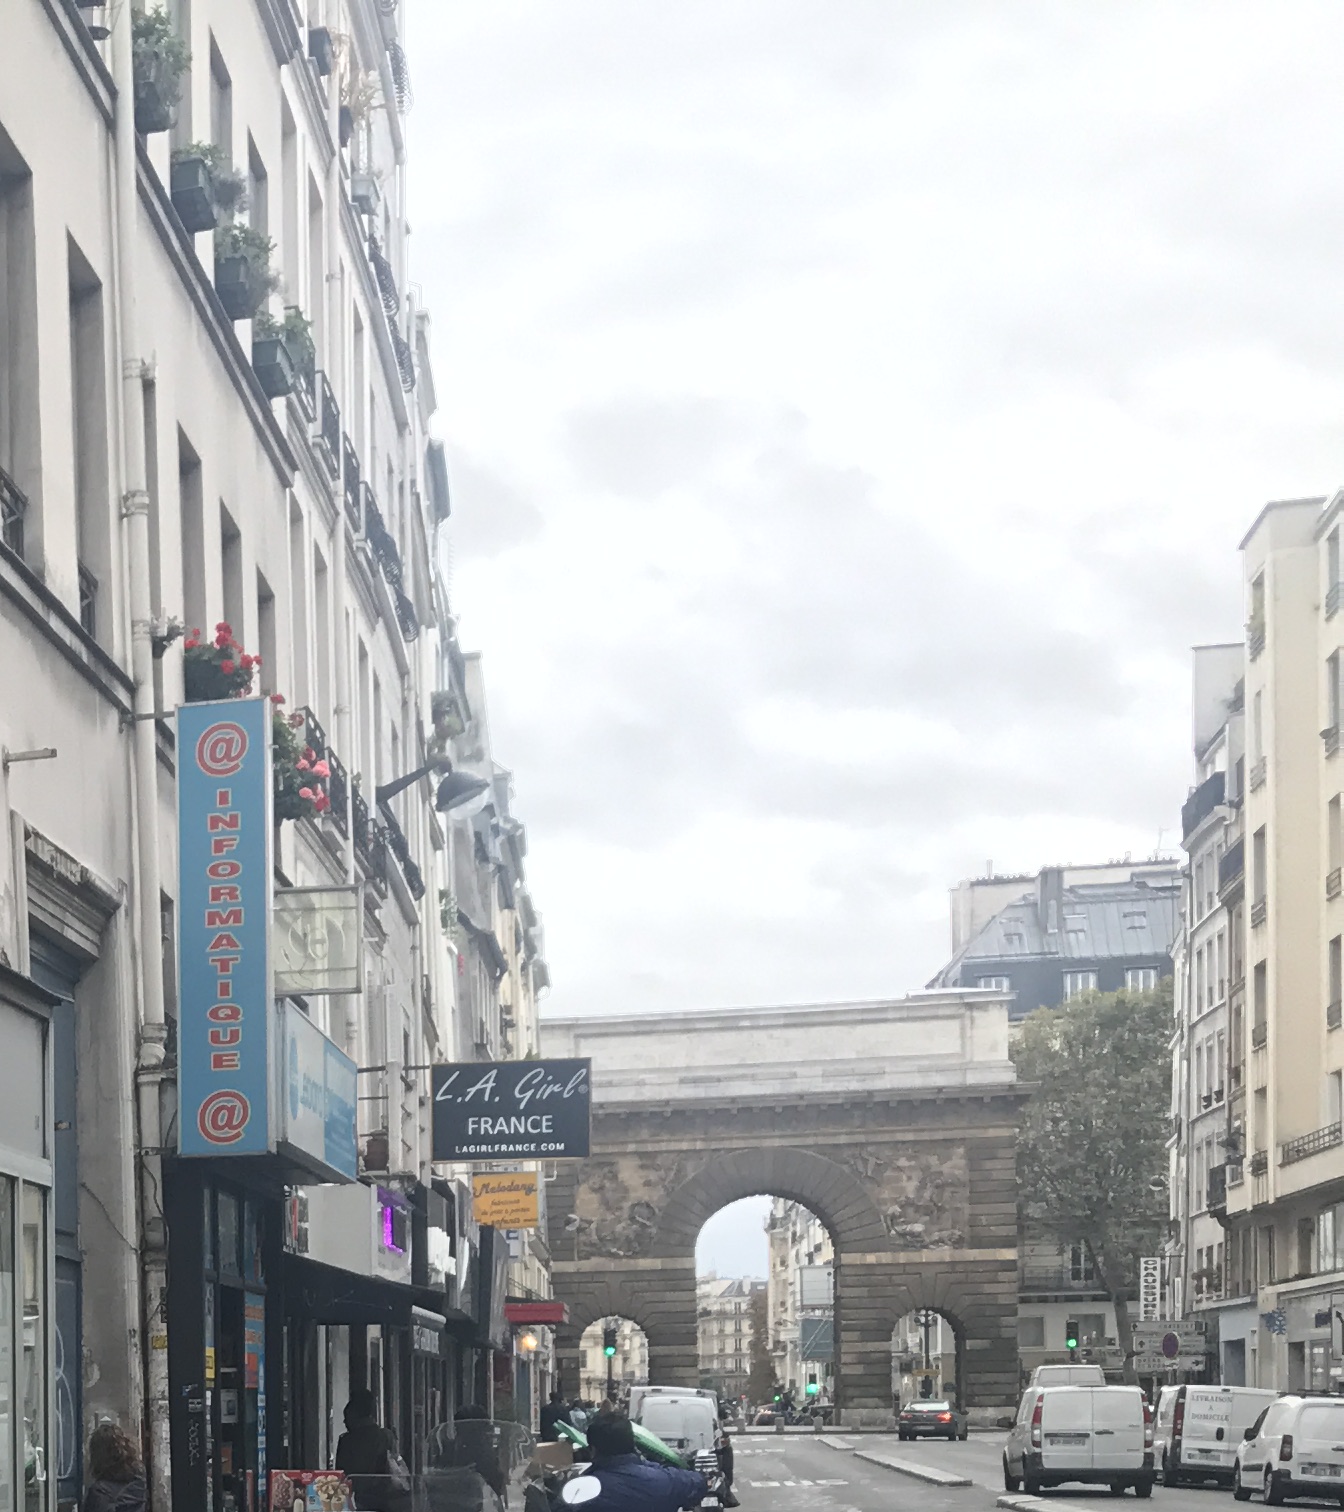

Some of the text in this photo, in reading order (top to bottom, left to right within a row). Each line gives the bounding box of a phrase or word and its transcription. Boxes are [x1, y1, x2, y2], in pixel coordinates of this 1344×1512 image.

[205, 787, 244, 1071] INFORMATIQUE
[435, 1067, 587, 1110] L.A. Girl
[467, 1114, 554, 1135] FRANCE
